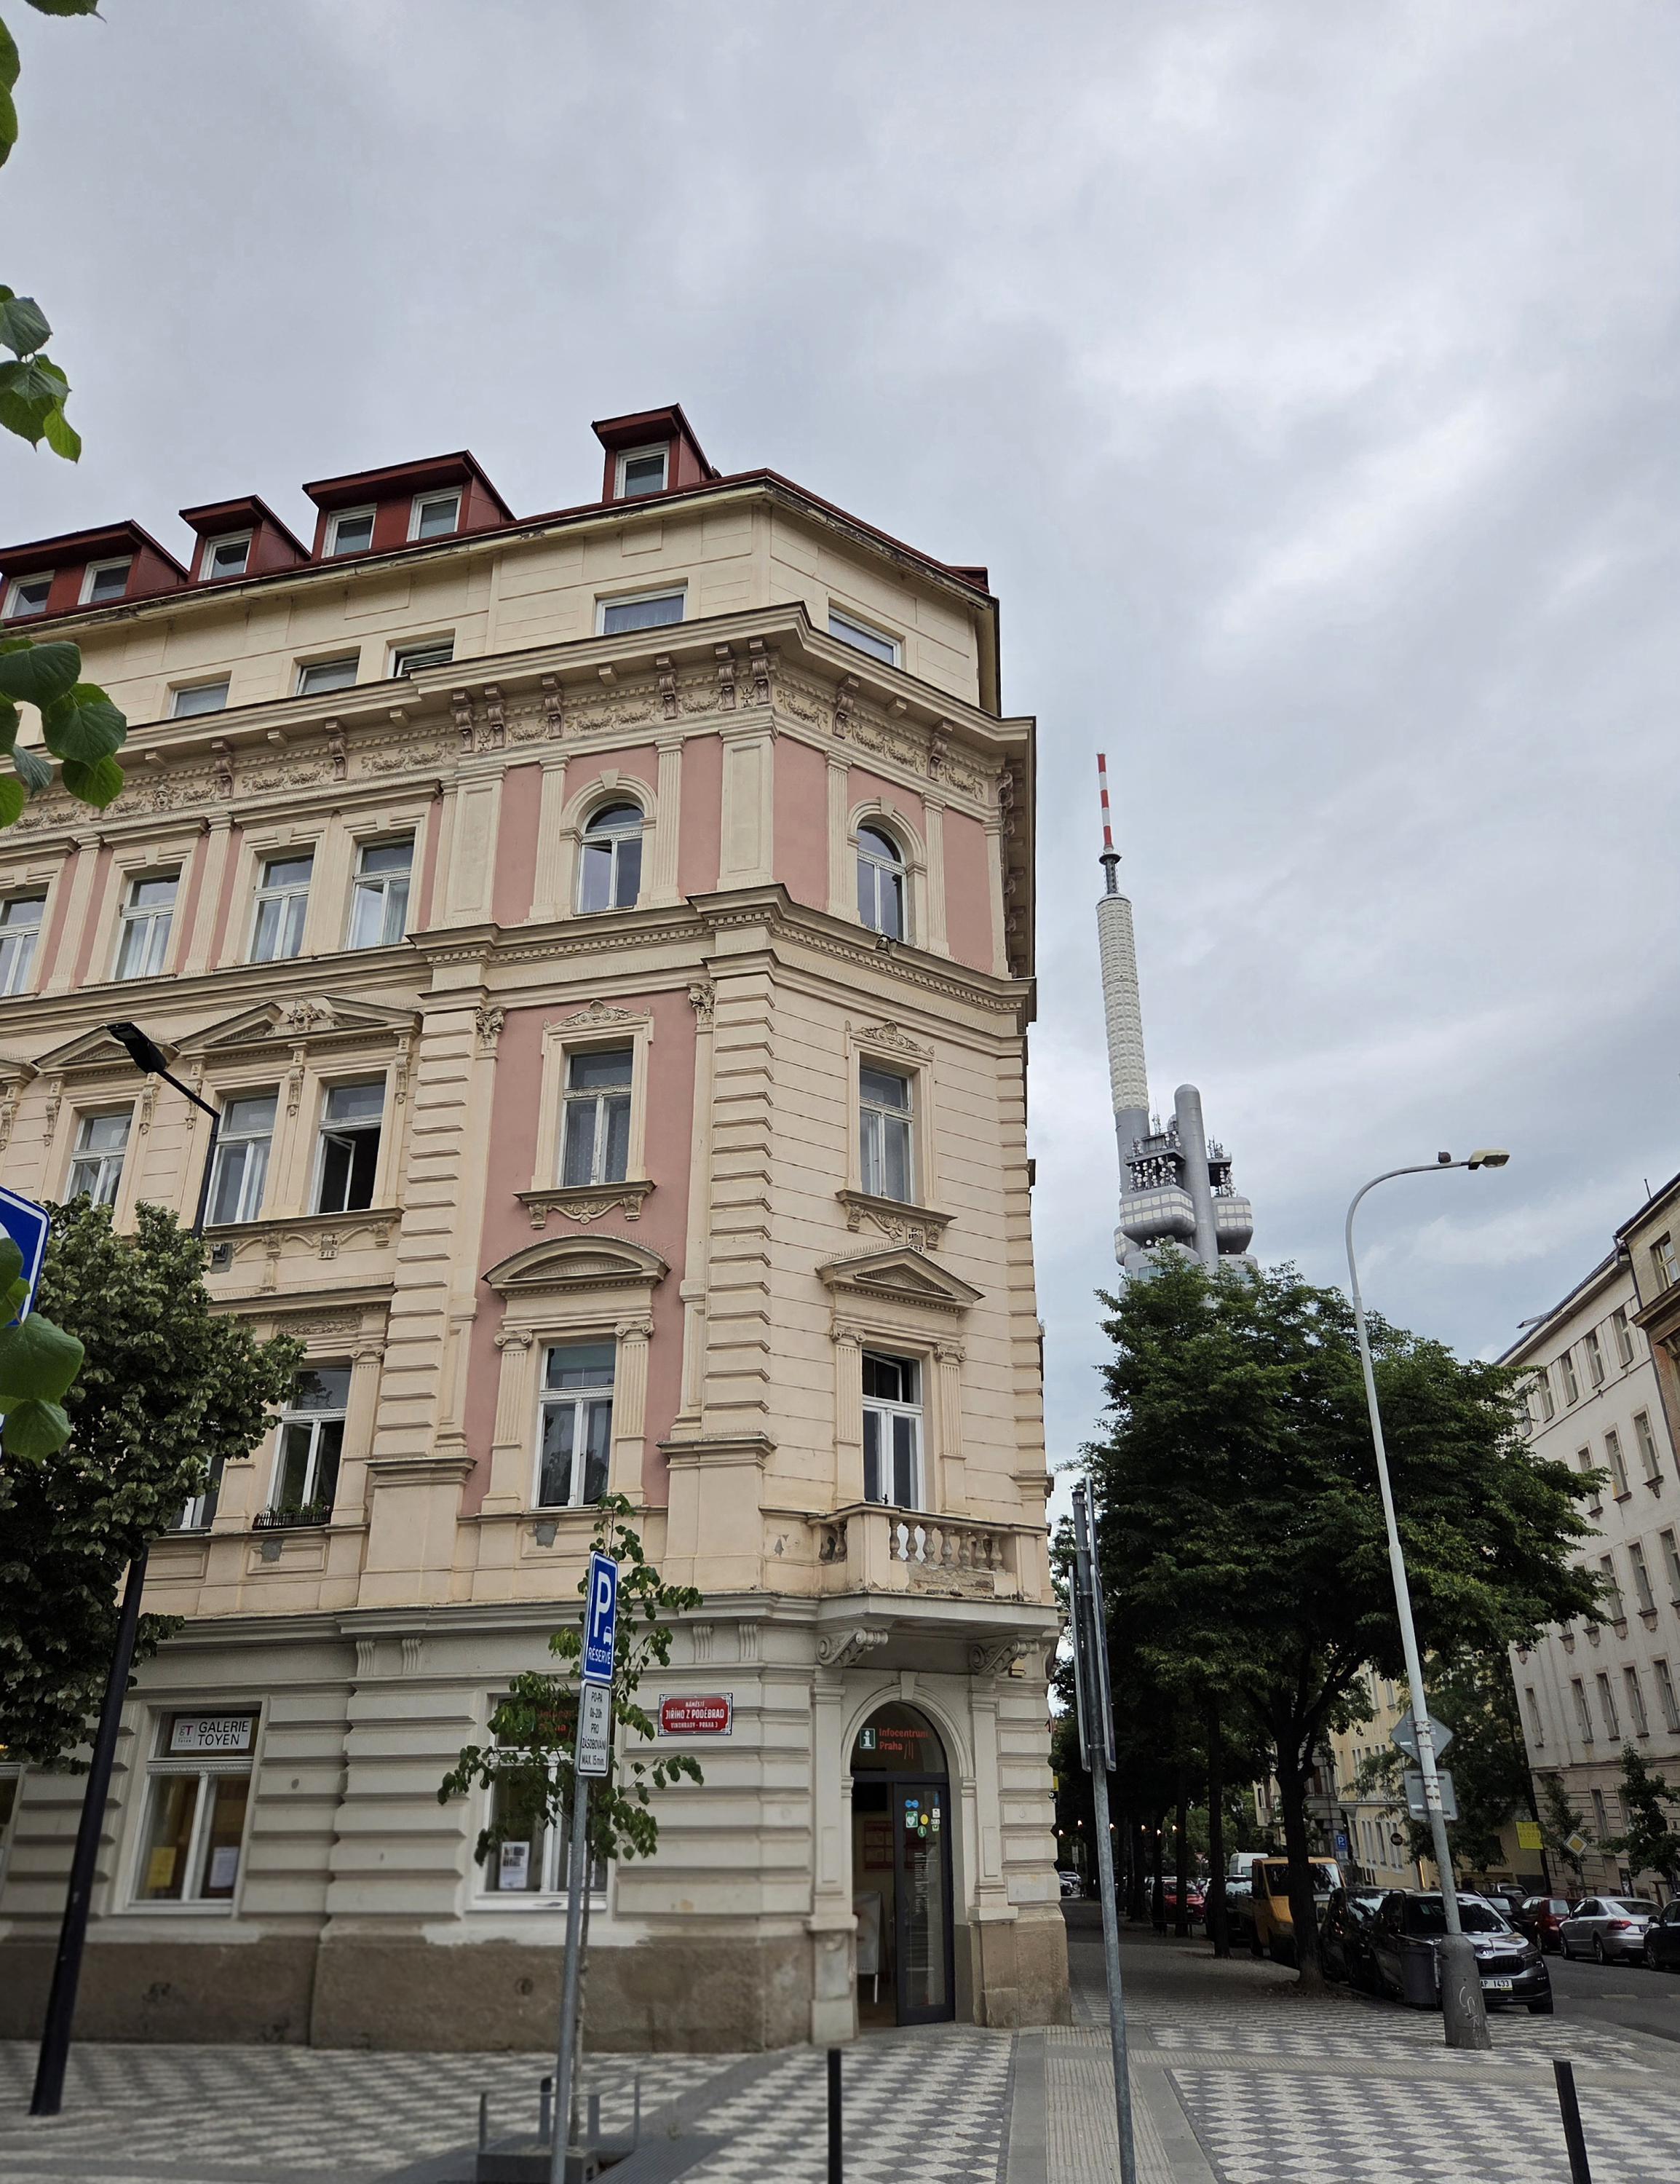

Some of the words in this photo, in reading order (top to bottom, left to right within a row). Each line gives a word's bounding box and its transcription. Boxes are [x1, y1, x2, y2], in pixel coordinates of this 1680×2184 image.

[593, 1570, 612, 1638] P
[587, 1645, 611, 1664] RÉSERVÉ
[665, 1707, 685, 1720] JIŘÍHO
[686, 1709, 690, 1719] Z
[692, 1707, 724, 1719] PODĚBRAD
[199, 1721, 249, 1733] GALERIE
[590, 1723, 599, 1735] PRO
[198, 1734, 240, 1746] TOYEN
[582, 1737, 606, 1750] ZÁSOBOVÁNÍ
[879, 1741, 903, 1751] Praha
[1494, 1979, 1509, 1987] 1433
